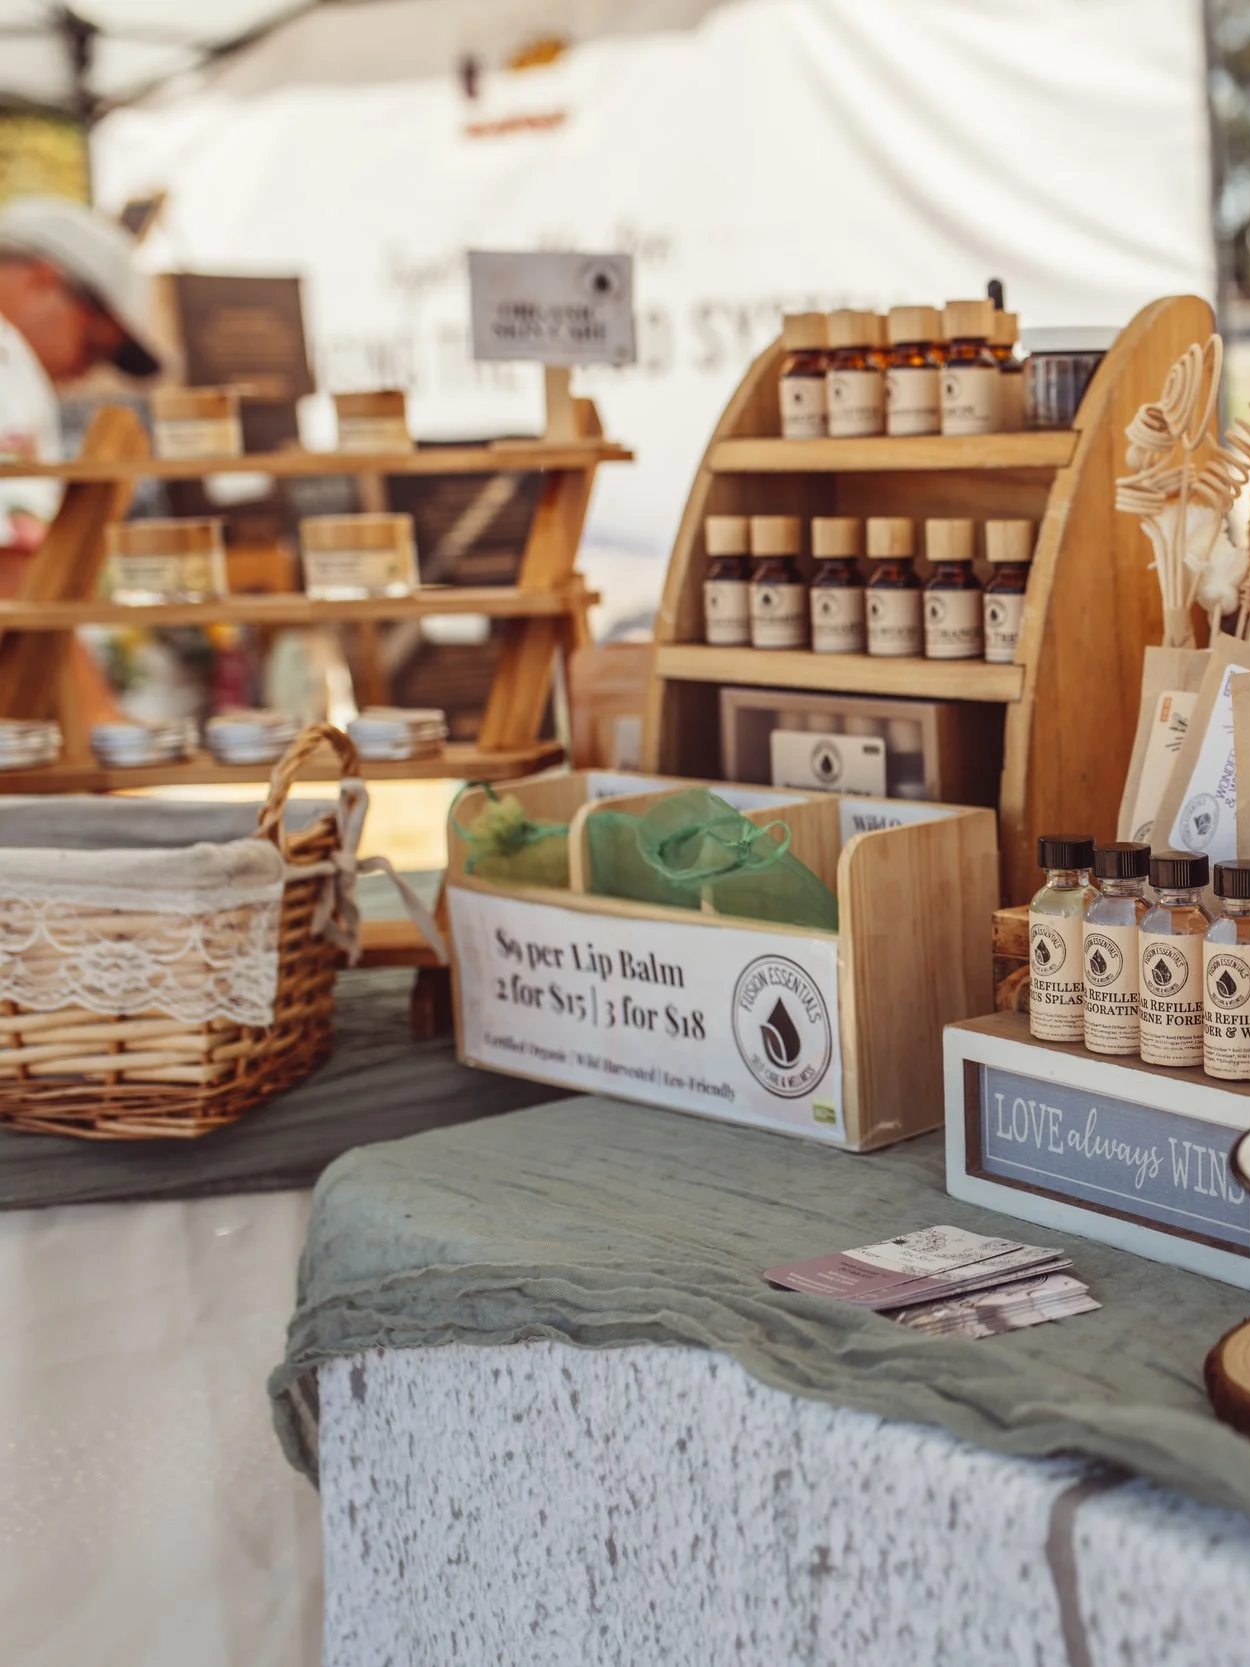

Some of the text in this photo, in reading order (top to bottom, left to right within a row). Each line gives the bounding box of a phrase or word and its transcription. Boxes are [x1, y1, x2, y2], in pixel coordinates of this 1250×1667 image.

[1093, 937, 1119, 960] ESSENTIALS
[1156, 947, 1184, 968] ESSENTIALS
[526, 941, 564, 971] per
[571, 943, 612, 982] Lip
[619, 949, 686, 989] Balm
[1220, 958, 1249, 979] ESSENTIALS
[739, 966, 823, 1025] FUSION ESSENTIALS
[1045, 992, 1083, 1006] SPLAS
[1150, 997, 1203, 1013] REFILLE
[495, 978, 507, 1000] 2
[510, 973, 544, 1009] for
[549, 982, 587, 1021] $15
[606, 999, 616, 1029] 3
[622, 994, 659, 1033] for
[664, 1000, 707, 1041] $18
[1085, 1001, 1139, 1016] GORATIN
[1140, 1010, 1163, 1025] RENE
[1204, 1026, 1222, 1038] DER
[1225, 1027, 1238, 1039] &
[994, 1092, 1064, 1154] LOVE
[1067, 1108, 1164, 1189] always
